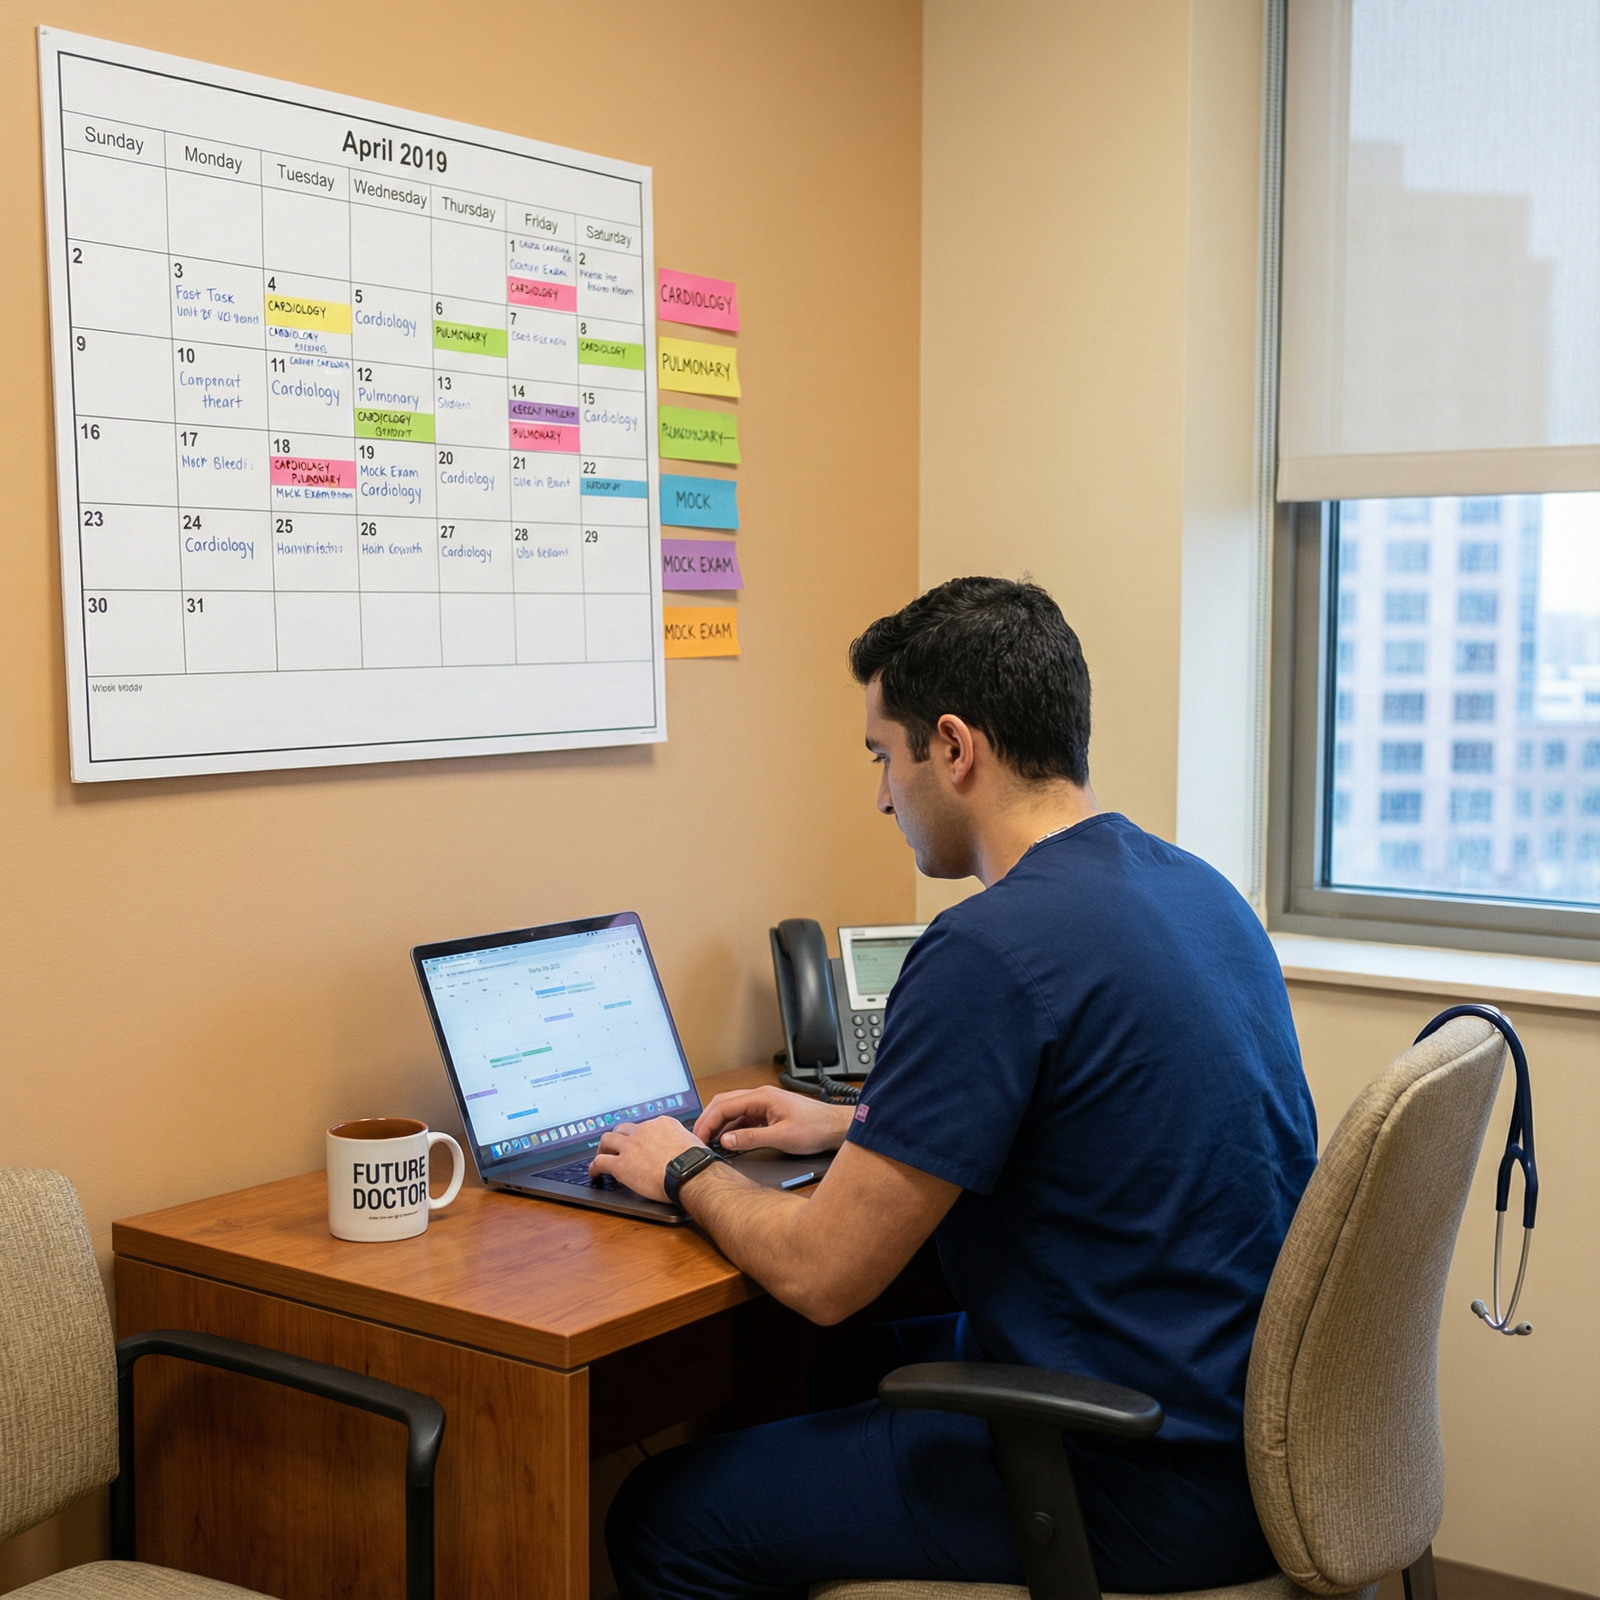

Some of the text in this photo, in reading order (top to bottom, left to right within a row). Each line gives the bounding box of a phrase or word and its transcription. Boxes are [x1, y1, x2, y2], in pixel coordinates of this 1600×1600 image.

[85, 126, 144, 155] Sunday
[185, 145, 242, 174] Monday
[342, 130, 448, 173] April 2019
[277, 163, 335, 192] Tuesday
[354, 178, 427, 209] Wednesday
[442, 196, 495, 222] Thursday
[525, 213, 558, 234] Friday
[586, 225, 632, 249] Saturday
[510, 240, 515, 252] 1
[73, 247, 83, 264] 2
[579, 252, 586, 265] 2
[174, 263, 183, 278] 3
[268, 276, 276, 291] 4
[355, 289, 363, 303] 5
[660, 284, 732, 315] CARDIOLOGY
[435, 302, 443, 315] 6
[355, 310, 416, 338] Cardiology
[510, 312, 517, 325] 7
[580, 323, 587, 335] 8
[76, 335, 86, 351] 9
[177, 347, 195, 364] 10
[271, 358, 286, 373] 11
[662, 352, 731, 382] PULMONARY
[357, 367, 373, 382] 12
[437, 376, 452, 391] 13
[511, 385, 525, 398] 14
[271, 379, 340, 407] Cardiology
[358, 387, 419, 411] Pulmonary
[582, 392, 595, 405] 15
[584, 409, 638, 432] Cardiology
[81, 423, 100, 440] 16
[180, 431, 198, 447] 17
[274, 438, 290, 454] 18
[359, 445, 375, 459] 19
[438, 451, 453, 465] 20
[513, 456, 526, 470] 21
[360, 465, 419, 478] Mock Exam
[583, 461, 596, 474] 22
[440, 470, 495, 491] Cardiology
[361, 481, 422, 504] Cardiology
[676, 490, 711, 510] MOCK
[83, 510, 104, 527] 23
[183, 515, 202, 530] 24
[275, 519, 293, 534] 25
[361, 522, 377, 537] 26
[440, 525, 455, 538] 27
[514, 528, 529, 541] 28
[585, 530, 598, 543] 29
[185, 535, 255, 560] Cardiology
[441, 544, 492, 563] Cardiology
[663, 555, 735, 574] MOCK EXAM
[88, 597, 108, 614] 30
[186, 597, 204, 613] 31
[664, 622, 732, 641] MOCK EXAM
[353, 1155, 425, 1184] FUTURE
[353, 1181, 427, 1210] DOCTOR
